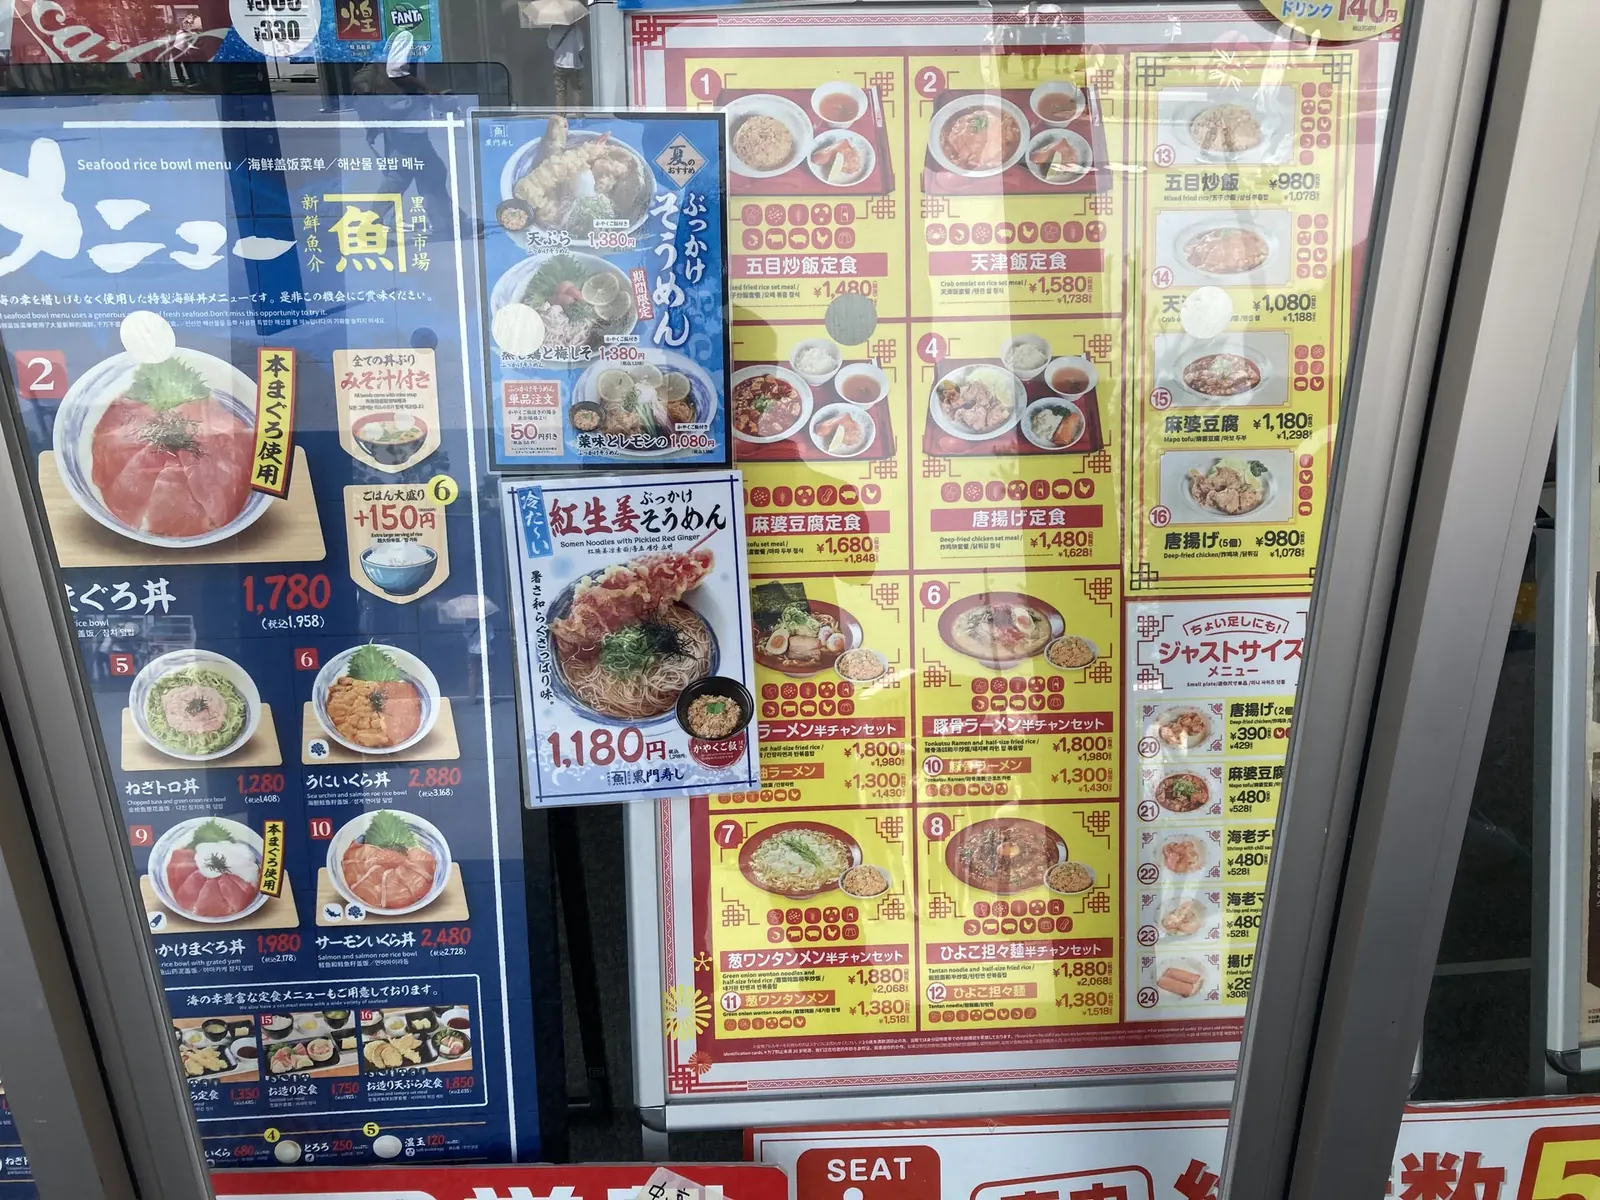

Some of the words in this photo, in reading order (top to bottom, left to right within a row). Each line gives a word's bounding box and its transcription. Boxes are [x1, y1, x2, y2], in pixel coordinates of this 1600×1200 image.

[1282, 1, 1334, 19] ドリンク
[1338, 0, 1398, 23] 140円
[254, 19, 301, 42] ¥330
[700, 73, 710, 95] 1
[923, 71, 937, 93] 2
[667, 144, 695, 167] 夏の
[1156, 148, 1172, 164] 13
[77, 158, 130, 172] Seafood
[133, 159, 157, 171] rice
[161, 158, 192, 171] bowl
[196, 161, 232, 171] menu
[376, 157, 399, 172] 덮밥
[402, 157, 425, 171] 메뉴
[667, 166, 695, 174] おすすめ
[1164, 172, 1240, 192] 五目炒飯
[1269, 172, 1316, 191] ¥980
[1284, 190, 1316, 202] ¥1,078
[301, 194, 324, 273] 新鮮魚介
[410, 195, 430, 273] 黒門市場
[527, 230, 571, 247] 天ぷら
[588, 231, 636, 249] 1,380円
[682, 192, 708, 284] ぶっかけ
[746, 255, 858, 275] 五目炒飯定食
[971, 252, 1067, 271] 天津飯定食
[650, 193, 690, 347] そうめん
[1154, 270, 1170, 286] 14
[813, 280, 872, 298] ¥1,480
[1029, 275, 1087, 295] ¥1,580
[632, 269, 653, 319] 期間限定
[1057, 294, 1088, 304] ¥1,738
[1253, 294, 1311, 313] ¥1,080
[3, 311, 31, 320] seafood
[32, 311, 49, 319] bowl
[94, 312, 126, 322] generous
[261, 309, 300, 320] opportunity
[1283, 312, 1313, 322] ¥1,188
[600, 346, 645, 362] 1,380円
[925, 337, 939, 358] 4
[352, 354, 416, 368] 全ての丼ぶり
[27, 357, 55, 391] 2
[340, 369, 430, 391] みそ汁付き
[508, 393, 554, 406] 単品注文
[1152, 392, 1168, 407] 15
[256, 354, 291, 486] 本まぐろ使用
[1164, 414, 1239, 434] 麻婆豆腐
[1253, 412, 1307, 432] ¥1,180
[510, 423, 558, 441] 50円引き
[1276, 430, 1309, 441] ¥1,298
[578, 434, 666, 449] 薬味とレモンの
[670, 434, 715, 450] 1,080円
[362, 488, 425, 501] ごはん大盛り
[433, 479, 451, 501] 6
[640, 489, 693, 506] ぶっかけ
[353, 504, 436, 531] +150円
[549, 494, 641, 538] 紅生姜
[640, 504, 727, 533] そうめん
[751, 514, 861, 534] 麻婆豆腐定食
[972, 508, 1066, 528] 唐揚げ定食
[1151, 509, 1168, 524] 16
[560, 540, 585, 548] Somen
[586, 538, 615, 546] Noodles
[616, 537, 632, 545] with
[634, 535, 660, 544] Pickled
[662, 534, 675, 542] Red
[677, 533, 700, 542] Ginger
[816, 536, 873, 556] ¥1,680
[1030, 531, 1088, 550] ¥1,480
[1256, 530, 1300, 547] ¥980
[844, 553, 875, 563] ¥1,848
[1058, 548, 1089, 558] ¥1,628
[1270, 548, 1301, 558] ¥1,078
[242, 573, 331, 615] 1,780
[927, 585, 941, 605] 6
[1190, 616, 1282, 636] ちょい足しにも!
[530, 570, 555, 705] 暑さ和らぐさっぱり味。
[300, 651, 313, 668] 6
[1158, 638, 1304, 665] ジャストサイズ
[116, 657, 129, 673] 5
[1207, 666, 1259, 678] メニュー
[933, 717, 1105, 734] 豚骨ラーメン半チャンセット
[1230, 726, 1267, 741] ¥390
[547, 727, 667, 768] 1,180円
[693, 743, 738, 753] かやくご飯
[844, 741, 900, 759] ¥1,800
[1053, 736, 1107, 754] ¥1,800
[1141, 741, 1157, 754] 20
[1229, 741, 1250, 750] ¥429
[871, 757, 901, 767] ¥1,980
[1078, 752, 1109, 762] ¥1,980
[925, 760, 941, 773] 10
[949, 759, 1023, 773] 豚骨ラーメン
[306, 770, 392, 789] うにいくら丼
[408, 767, 461, 788] 2,880
[633, 767, 685, 783] 黒門寿し
[844, 772, 901, 791] ¥1,300
[1051, 767, 1108, 785] ¥1,300
[125, 777, 200, 796] ねぎトロ丼
[236, 773, 285, 795] 1,280
[1079, 783, 1109, 793] ¥1,430
[872, 788, 902, 798] ¥1,430
[1229, 790, 1267, 804] ¥480
[1140, 805, 1155, 817] 21
[1229, 804, 1249, 813] ¥528
[311, 821, 331, 837] 10
[721, 824, 735, 844] 7
[931, 817, 944, 836] 8
[135, 828, 148, 844] 9
[261, 823, 282, 892] 本まぐろ使用
[1227, 852, 1264, 867] ¥480
[1140, 868, 1157, 880] 22
[1227, 867, 1247, 876] ¥528
[315, 931, 417, 950] サーモンいくら丼
[421, 927, 472, 948] 2,480
[1140, 929, 1156, 943] 23
[1226, 929, 1247, 938] ¥528
[256, 933, 302, 954] 1,980
[728, 949, 904, 969] 葱ワンタンメン半チャンセット
[940, 943, 1102, 961] ひよこ担々麺半チャンセット
[191, 959, 205, 967] with
[206, 958, 226, 968] grated
[1053, 961, 1108, 979] ¥1,880
[848, 968, 904, 986] ¥1,880
[1077, 977, 1109, 987] ¥2,068
[873, 984, 906, 994] ¥2,068
[929, 985, 945, 999] 12
[724, 995, 738, 1009] 11
[745, 992, 829, 1007] 葱ワンタンメン
[1055, 991, 1108, 1008] ¥1,380
[1140, 991, 1156, 1004] 24
[360, 1010, 372, 1020] 16
[849, 1000, 905, 1016] ¥1,380
[1082, 1008, 1109, 1017] ¥1,518
[261, 1015, 273, 1025] 15
[879, 1015, 906, 1024] ¥1,518
[268, 1084, 319, 1097] お造り定食
[331, 1082, 360, 1095] 1,750
[366, 1077, 443, 1091] お造り天ぷら定食
[445, 1076, 474, 1090] 1,850
[267, 1130, 276, 1141] 4
[367, 1123, 376, 1135] 5
[304, 1142, 330, 1152] とろろ
[333, 1139, 353, 1150] 250
[427, 1135, 445, 1146] 120
[234, 1145, 255, 1156] 680
[826, 1157, 912, 1183] SEAT
